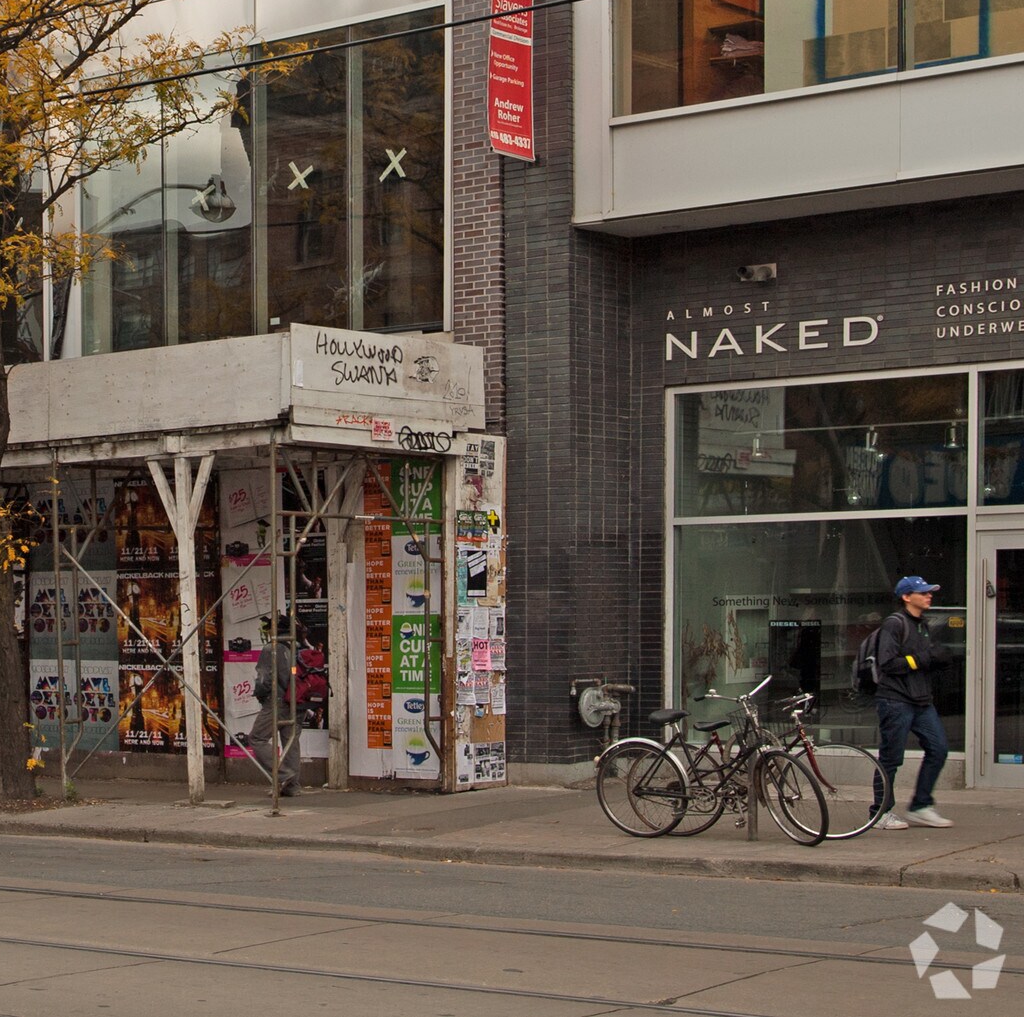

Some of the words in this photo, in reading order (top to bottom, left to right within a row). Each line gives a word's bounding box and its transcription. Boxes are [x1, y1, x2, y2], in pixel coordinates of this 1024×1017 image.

[494, 97, 524, 112] Andrew
[498, 110, 520, 123] Roher
[936, 277, 1018, 296] FASHION
[666, 301, 770, 321] ALMOST
[665, 316, 878, 361] NAKED
[713, 596, 769, 609] Something
[474, 641, 488, 650] HOT
[400, 655, 416, 668] AT
[125, 730, 162, 739] 11/21/11
